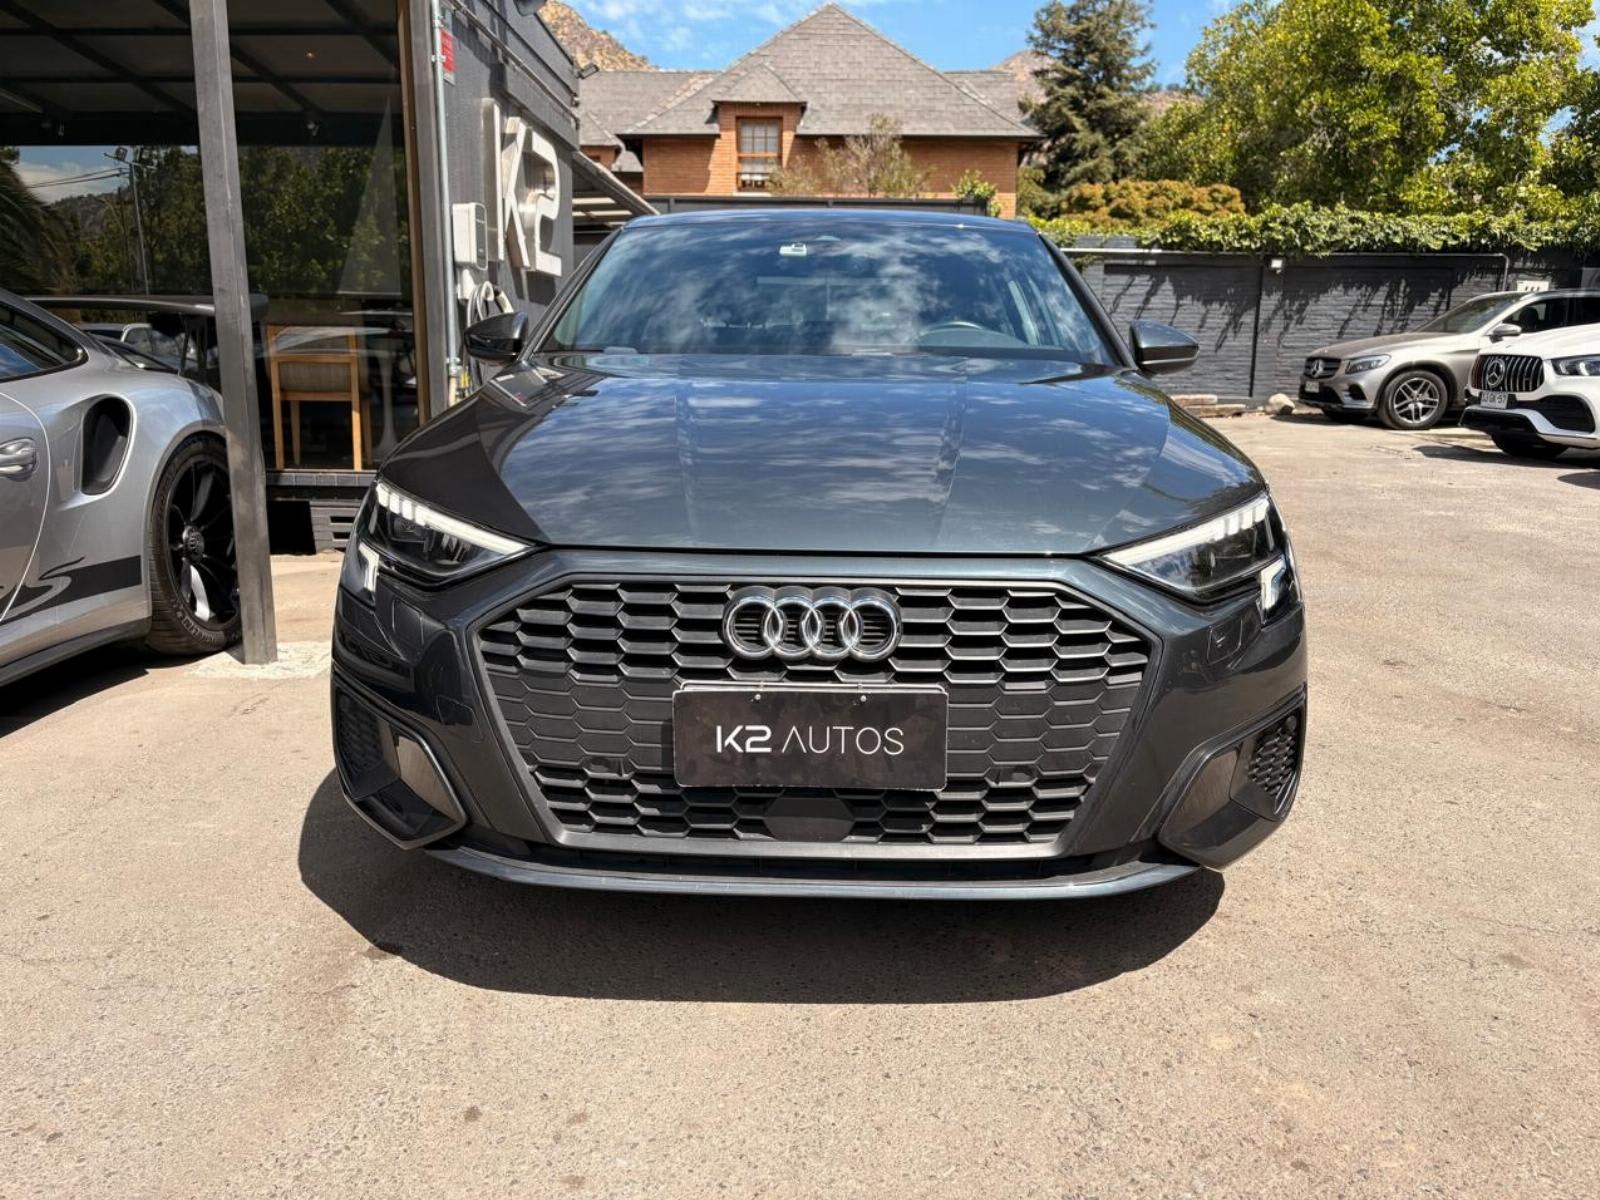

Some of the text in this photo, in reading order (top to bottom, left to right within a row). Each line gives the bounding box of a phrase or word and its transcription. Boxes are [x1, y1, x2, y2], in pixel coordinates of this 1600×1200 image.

[482, 98, 562, 276] K2
[716, 725, 905, 755] K2 AUTOS
